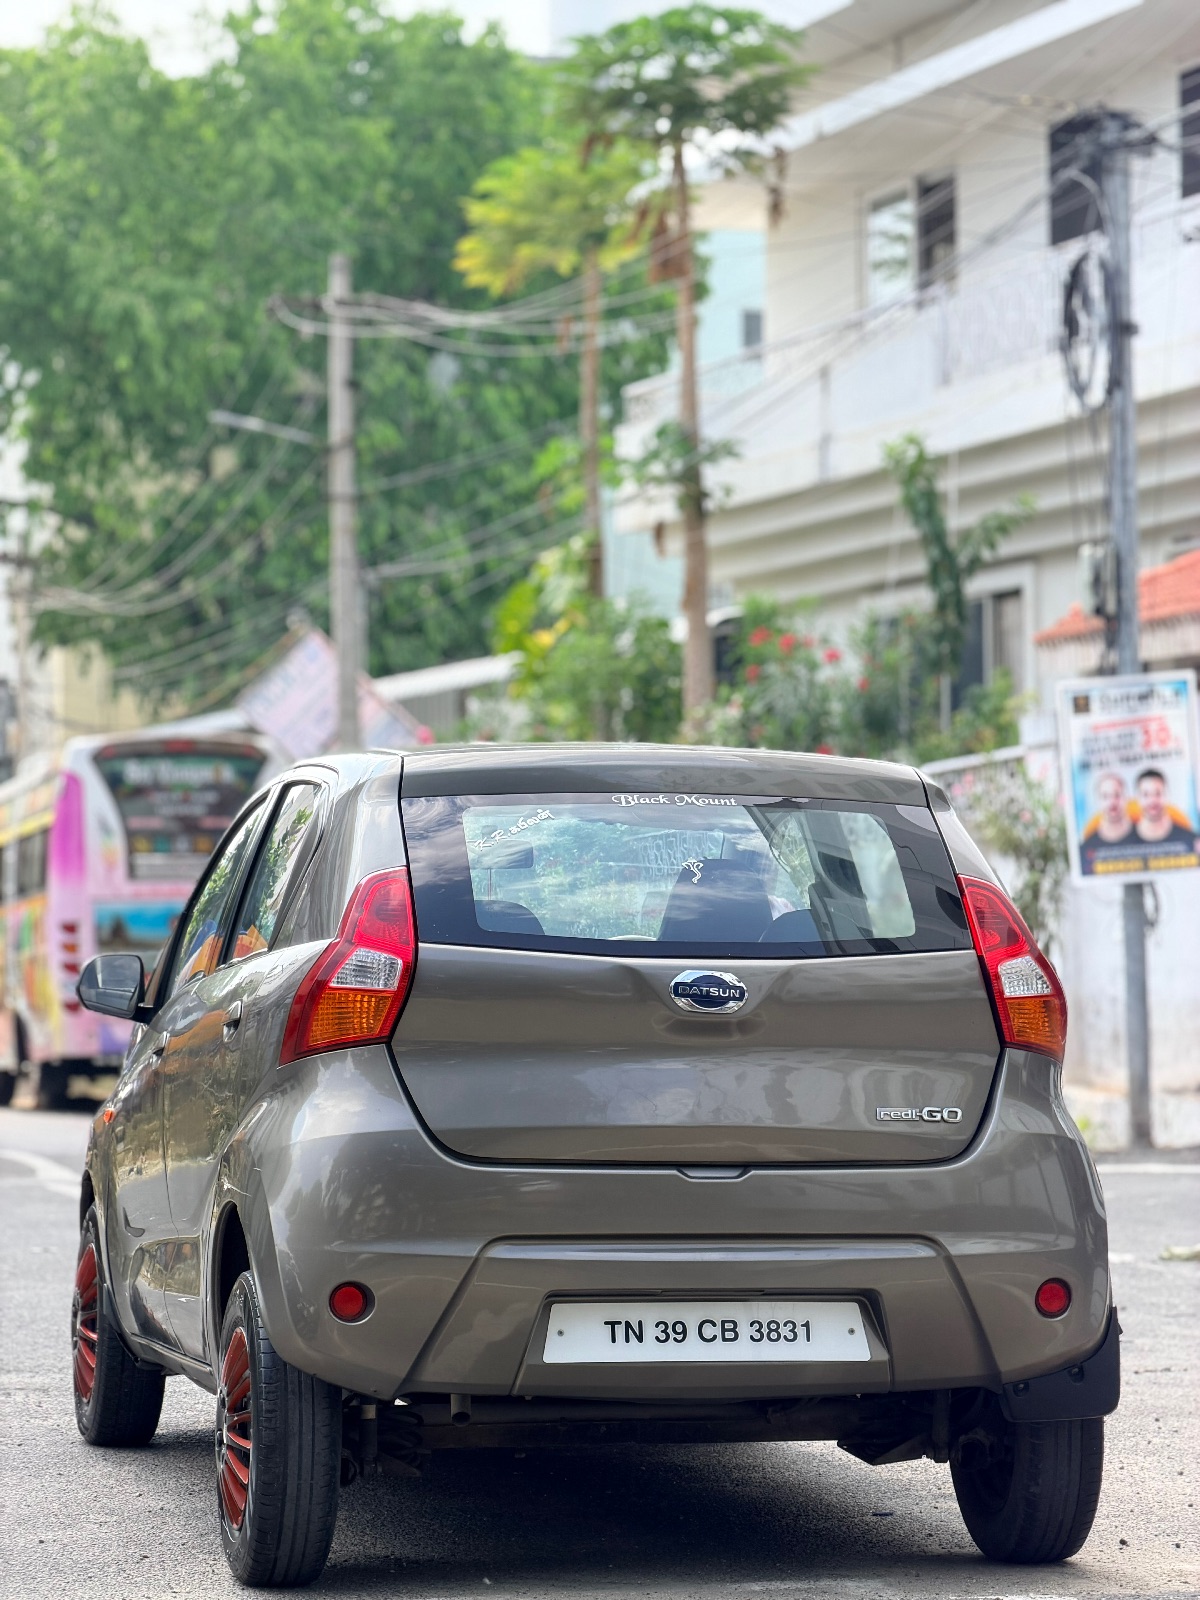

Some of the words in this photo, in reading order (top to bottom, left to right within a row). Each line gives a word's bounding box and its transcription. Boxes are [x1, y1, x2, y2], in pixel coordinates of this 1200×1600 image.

[611, 794, 670, 807] Black
[674, 794, 738, 807] Mount
[678, 985, 740, 998] DATSUN
[603, 1319, 644, 1344] TN
[654, 1319, 688, 1344] 39
[697, 1318, 740, 1343] CB
[749, 1319, 811, 1343] 3831
